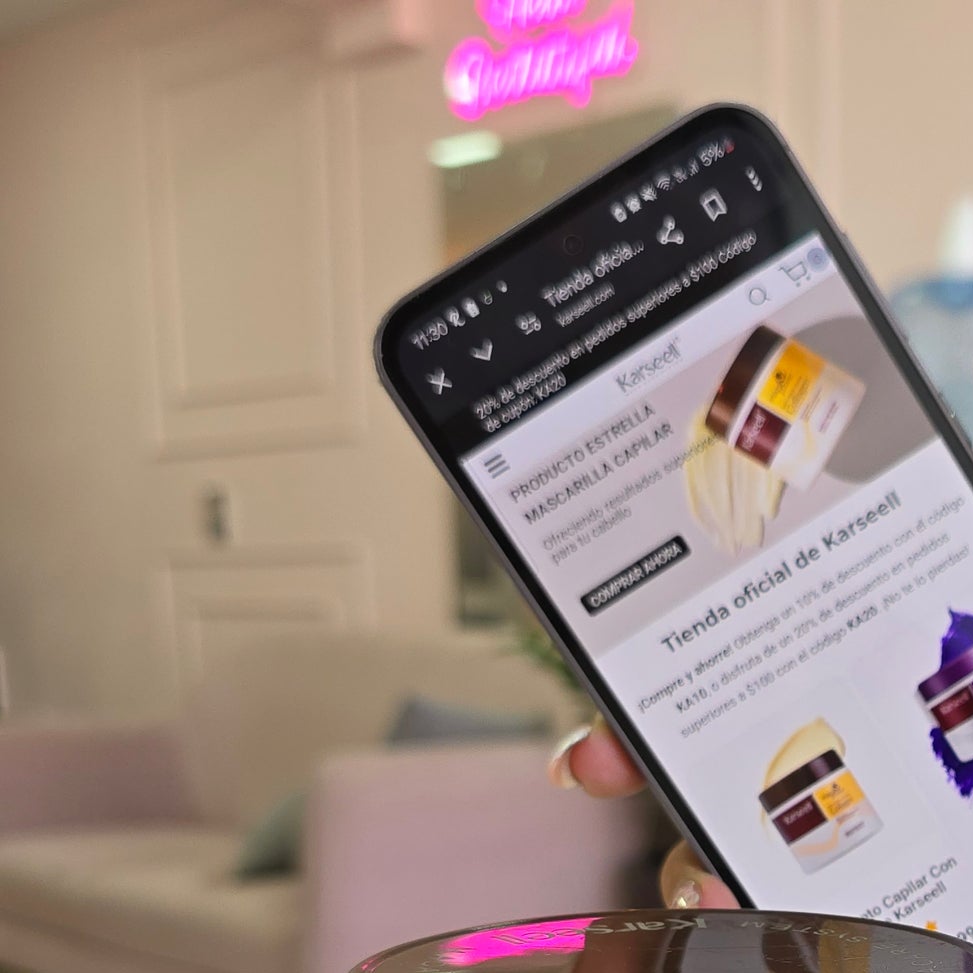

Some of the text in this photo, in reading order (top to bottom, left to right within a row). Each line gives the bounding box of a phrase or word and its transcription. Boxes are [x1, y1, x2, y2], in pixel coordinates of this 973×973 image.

[700, 145, 725, 166] 5%
[543, 268, 593, 308] Tienda
[411, 319, 449, 351] 11:30
[475, 396, 500, 419] 20%
[498, 387, 515, 404] de
[513, 352, 570, 395] descuento
[569, 344, 584, 359] en
[582, 315, 628, 352] pedidos
[626, 281, 683, 324] superiores
[681, 277, 691, 288] a
[688, 255, 719, 282] $100
[484, 416, 501, 432] de
[535, 373, 568, 400] KA20
[509, 402, 656, 502] PRODUCTO ESTRELLA
[524, 421, 675, 525] MASCARILLA CAPILAR
[588, 541, 682, 607] COMPRAR AHORA
[660, 489, 903, 654] Tienda oficial de Karseell
[880, 854, 958, 910] Capilar Con
[892, 880, 947, 921] Karseell
